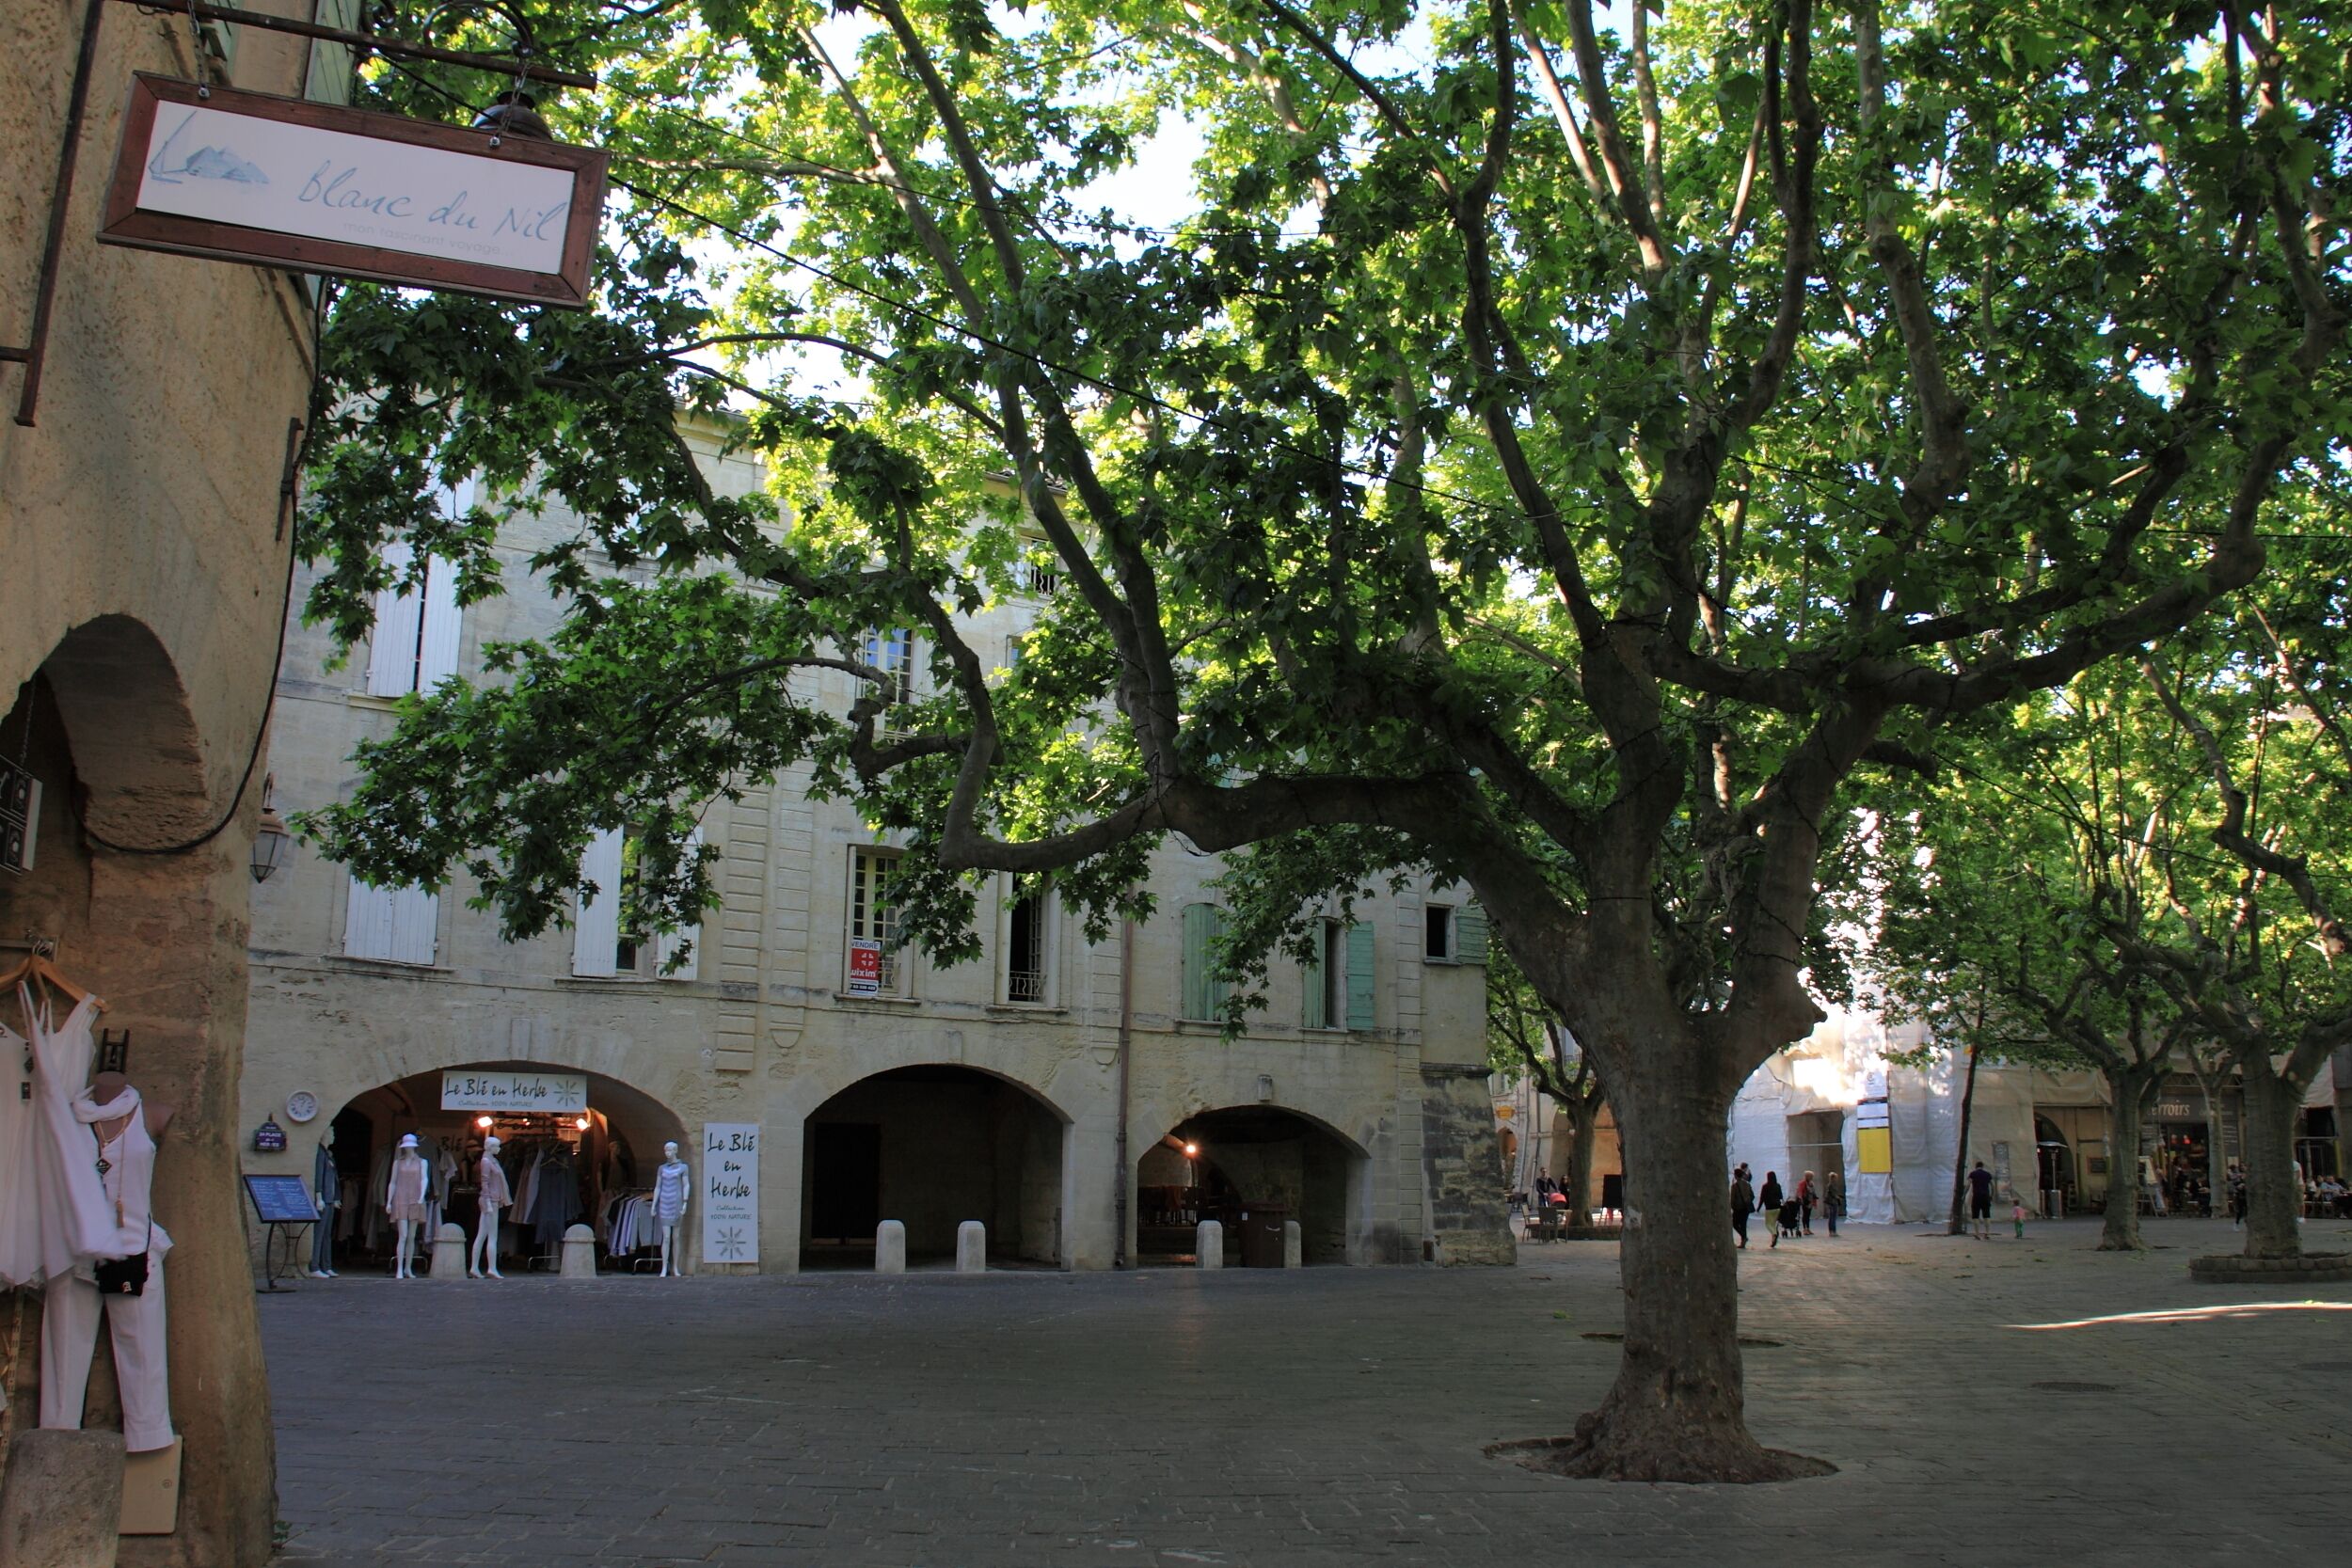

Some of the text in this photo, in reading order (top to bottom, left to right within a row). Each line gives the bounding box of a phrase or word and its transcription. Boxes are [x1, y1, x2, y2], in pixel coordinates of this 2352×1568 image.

[298, 159, 568, 241] Blanc du Nil
[342, 221, 374, 235] mon
[379, 225, 445, 246] fascinant
[851, 941, 880, 949] VENDRE
[444, 1075, 548, 1099] Le Blé en Herbe
[707, 1131, 755, 1152] Le Blé
[723, 1160, 741, 1172] en
[710, 1175, 751, 1199] Herbe
